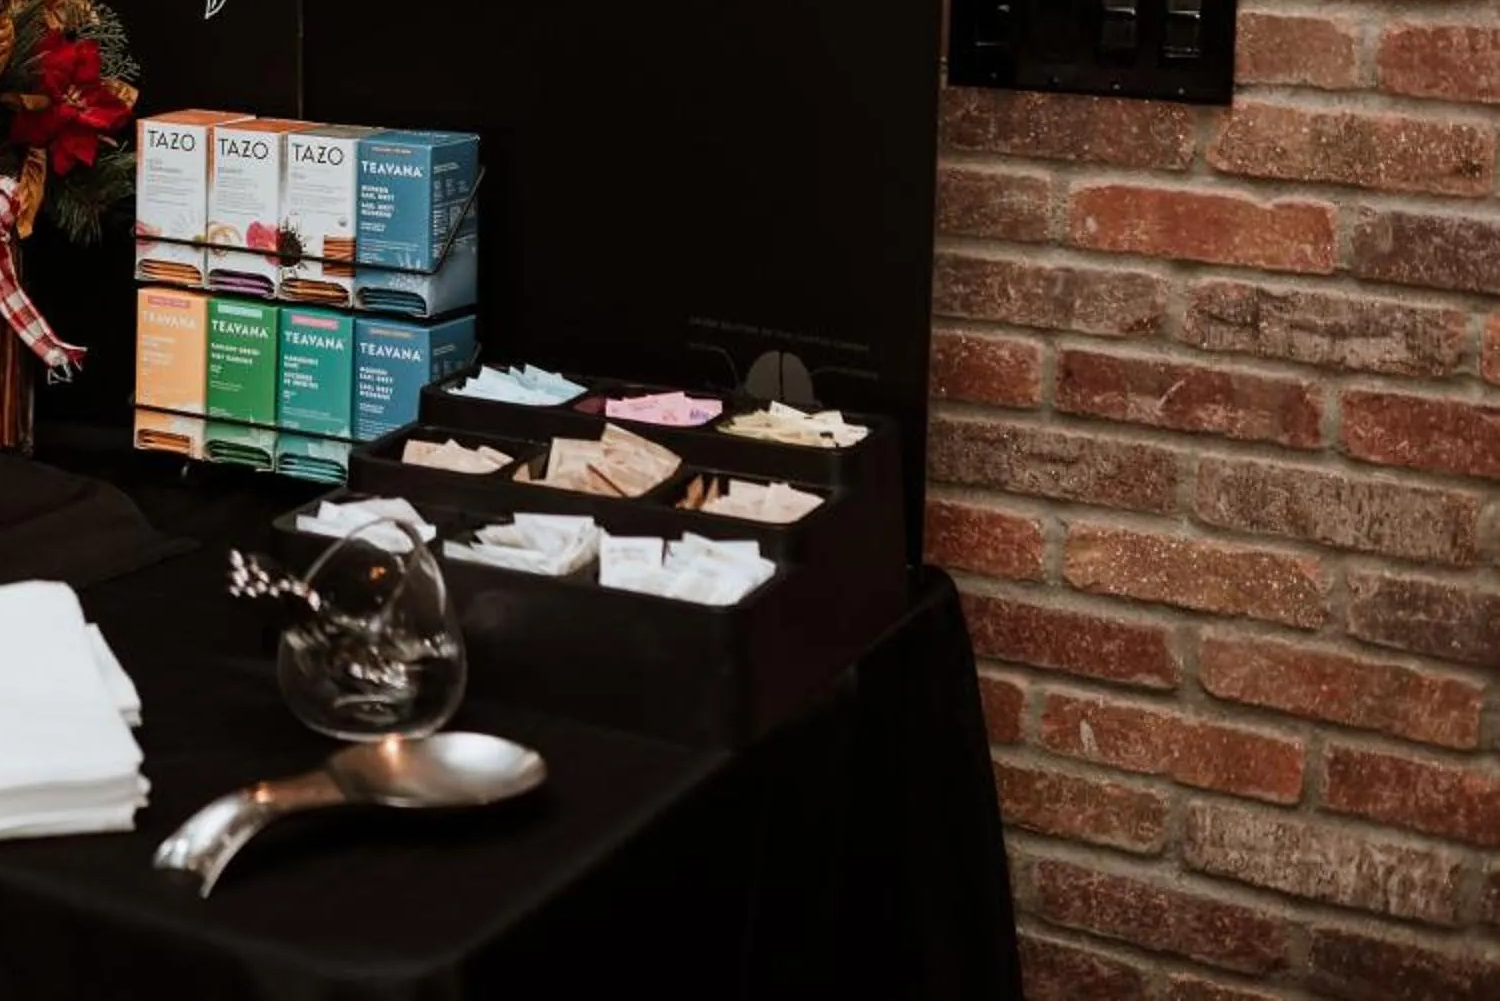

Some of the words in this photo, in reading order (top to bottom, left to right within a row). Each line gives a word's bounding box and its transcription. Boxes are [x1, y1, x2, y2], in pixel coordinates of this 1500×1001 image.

[147, 129, 196, 152] TAZO
[217, 138, 269, 160] TAZO
[291, 143, 345, 166] TAZO
[361, 160, 422, 178] TEAVANA
[143, 310, 197, 330] TEAVANA
[211, 319, 269, 339] TEAVANA
[284, 331, 344, 352] TEAVANA
[359, 342, 422, 362] TEAVANA
